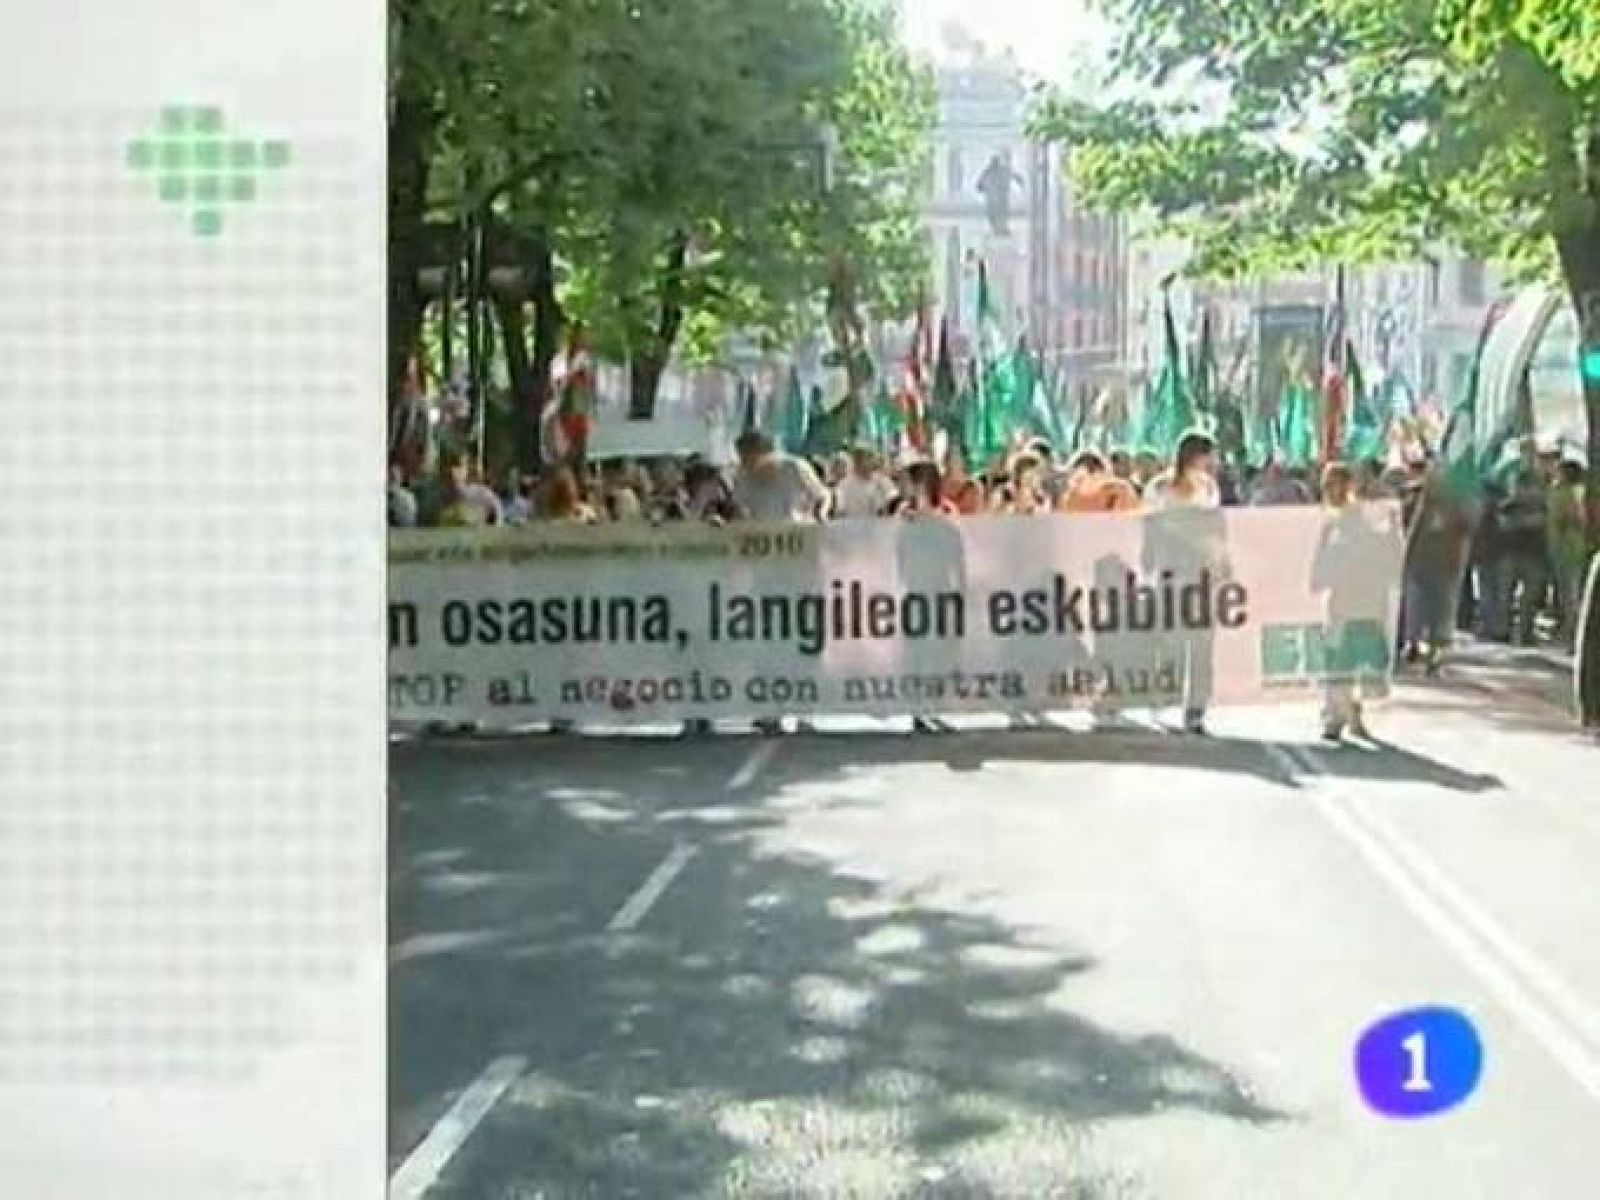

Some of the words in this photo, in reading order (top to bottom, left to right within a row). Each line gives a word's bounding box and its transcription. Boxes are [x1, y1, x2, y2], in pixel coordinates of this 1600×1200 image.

[739, 532, 804, 558] 2010
[442, 596, 690, 650] osasuna,
[709, 579, 965, 655] langileon
[988, 568, 1249, 637] eskubide
[489, 670, 536, 705] al
[560, 669, 732, 709] negocio
[745, 675, 819, 702] con
